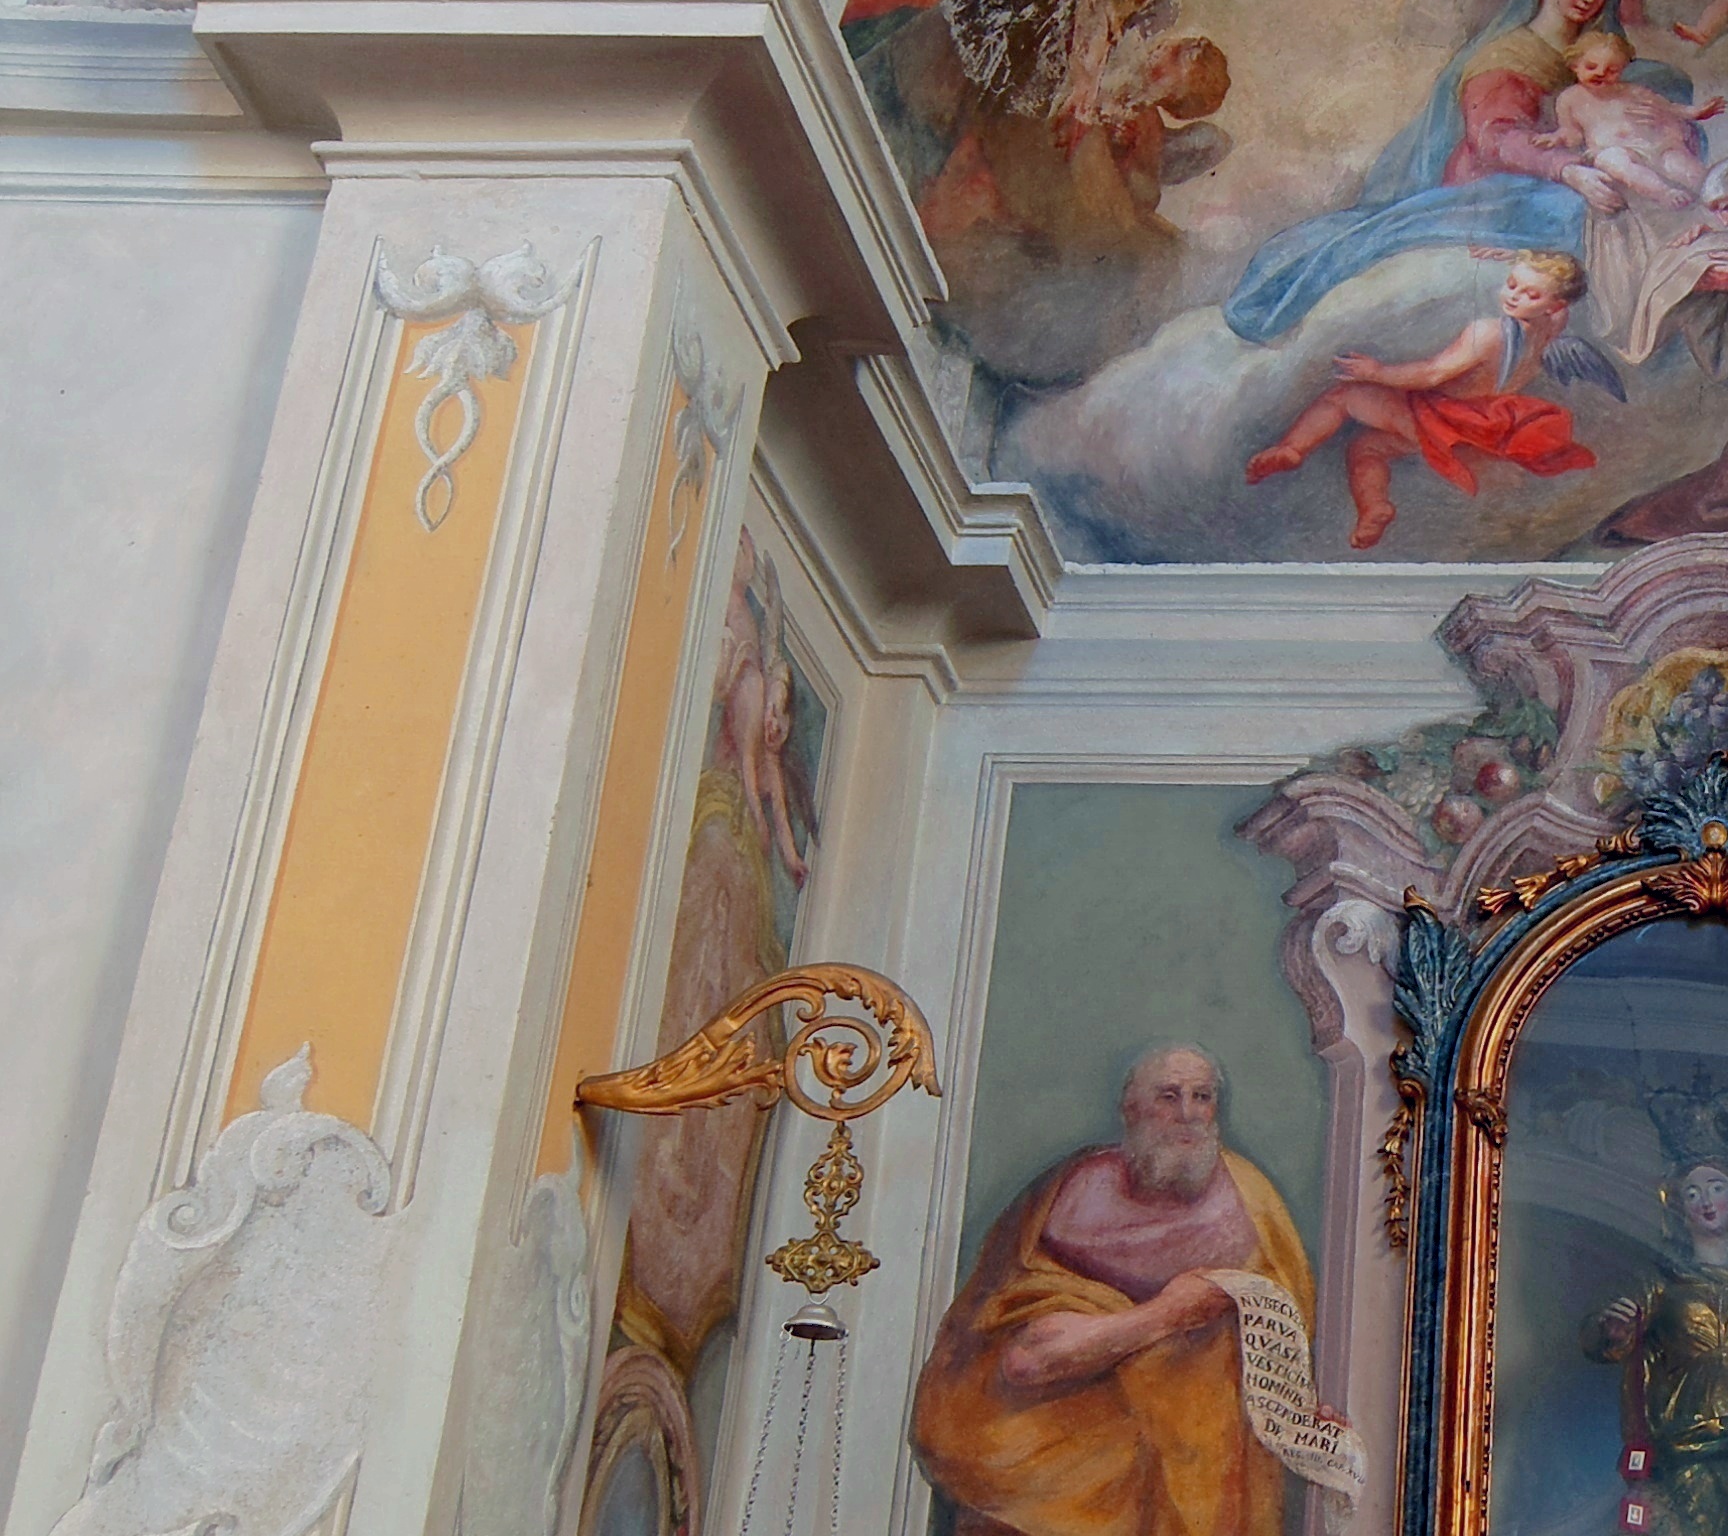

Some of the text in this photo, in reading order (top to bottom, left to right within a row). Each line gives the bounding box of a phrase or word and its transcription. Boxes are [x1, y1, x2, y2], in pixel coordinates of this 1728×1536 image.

[1244, 1313, 1297, 1343] PARVA
[1245, 1332, 1301, 1363] QVASI
[1246, 1372, 1303, 1407] HOMINIS
[1295, 1432, 1339, 1455] MARI
